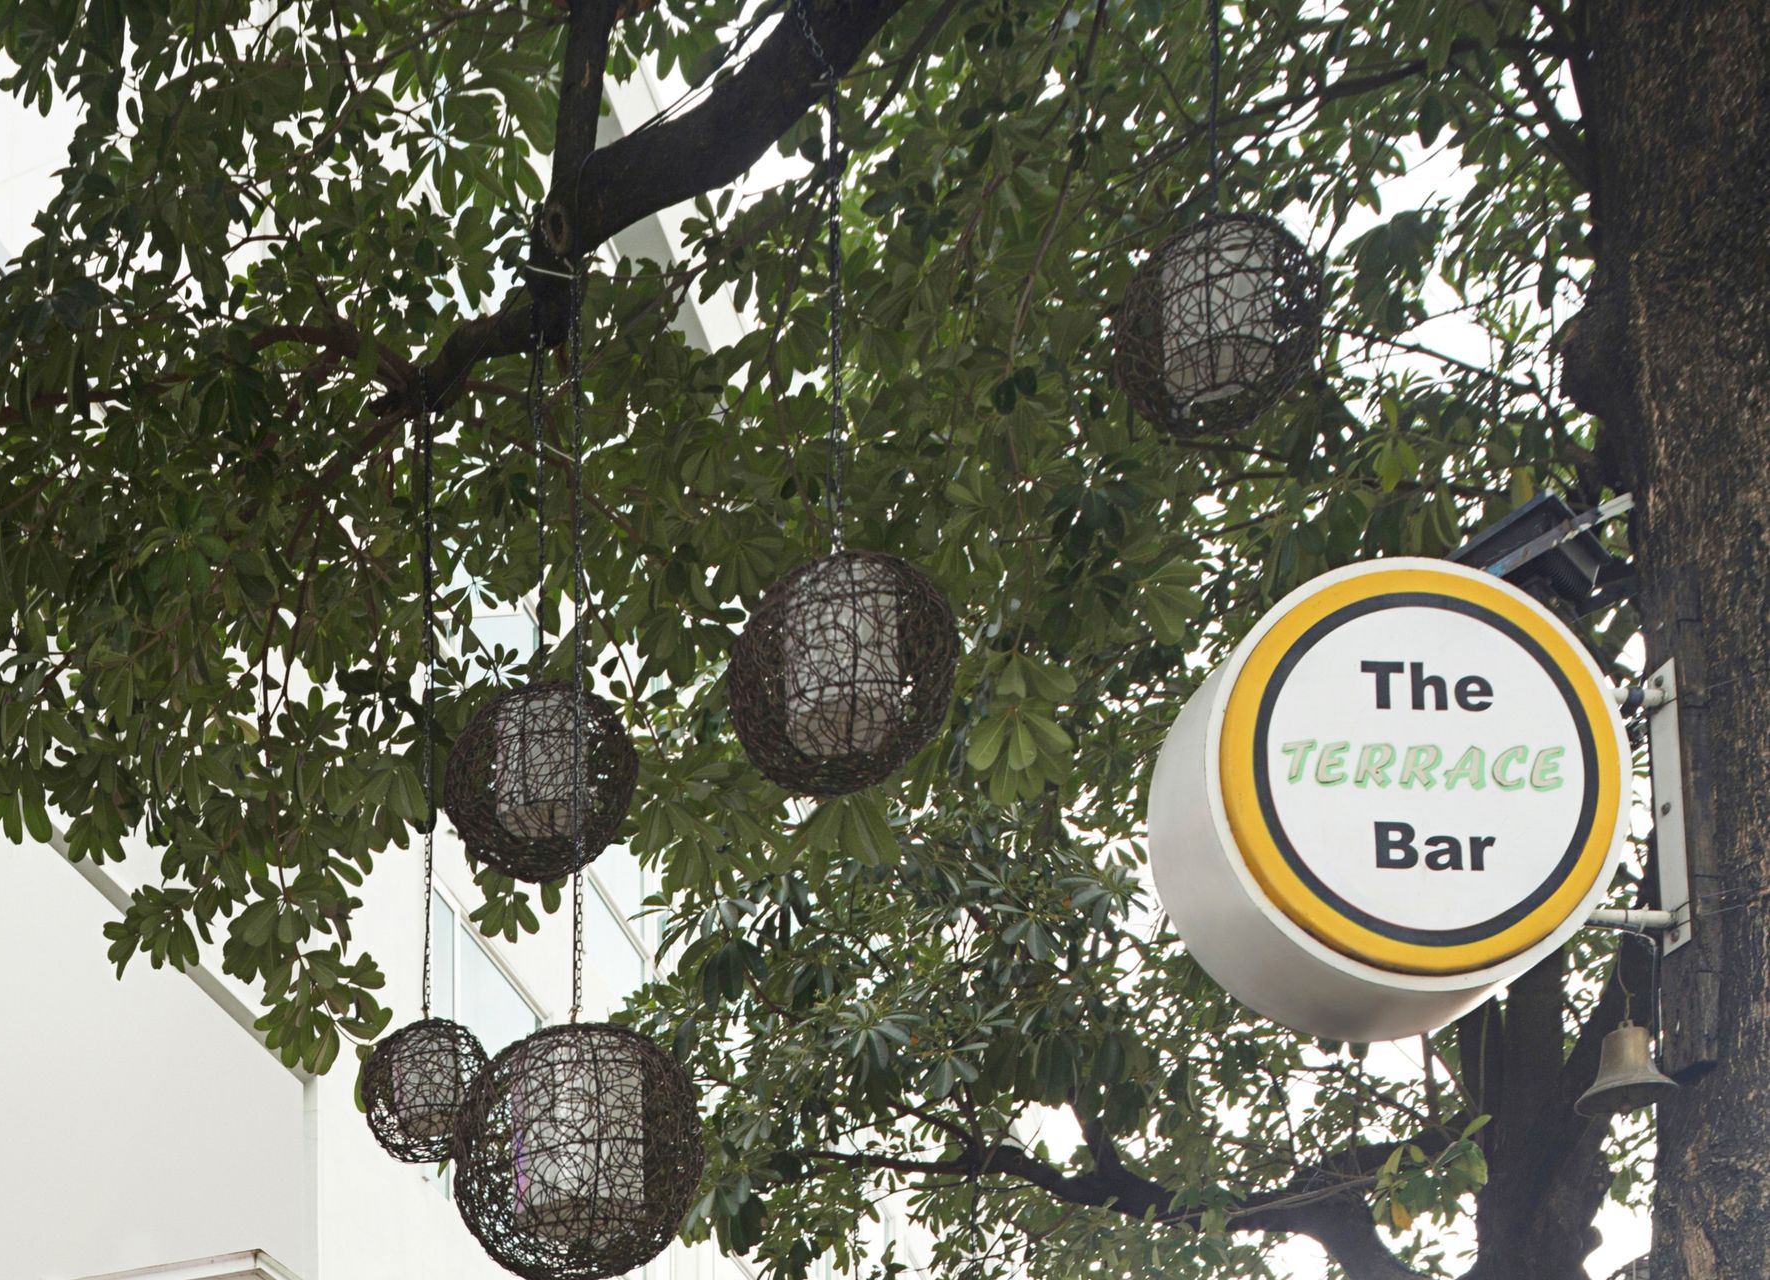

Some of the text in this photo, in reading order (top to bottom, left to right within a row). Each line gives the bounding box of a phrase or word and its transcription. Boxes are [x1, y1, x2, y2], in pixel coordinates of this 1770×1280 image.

[1360, 660, 1494, 712] The
[1282, 739, 1566, 792] TERRACE
[1373, 821, 1496, 871] Bar
